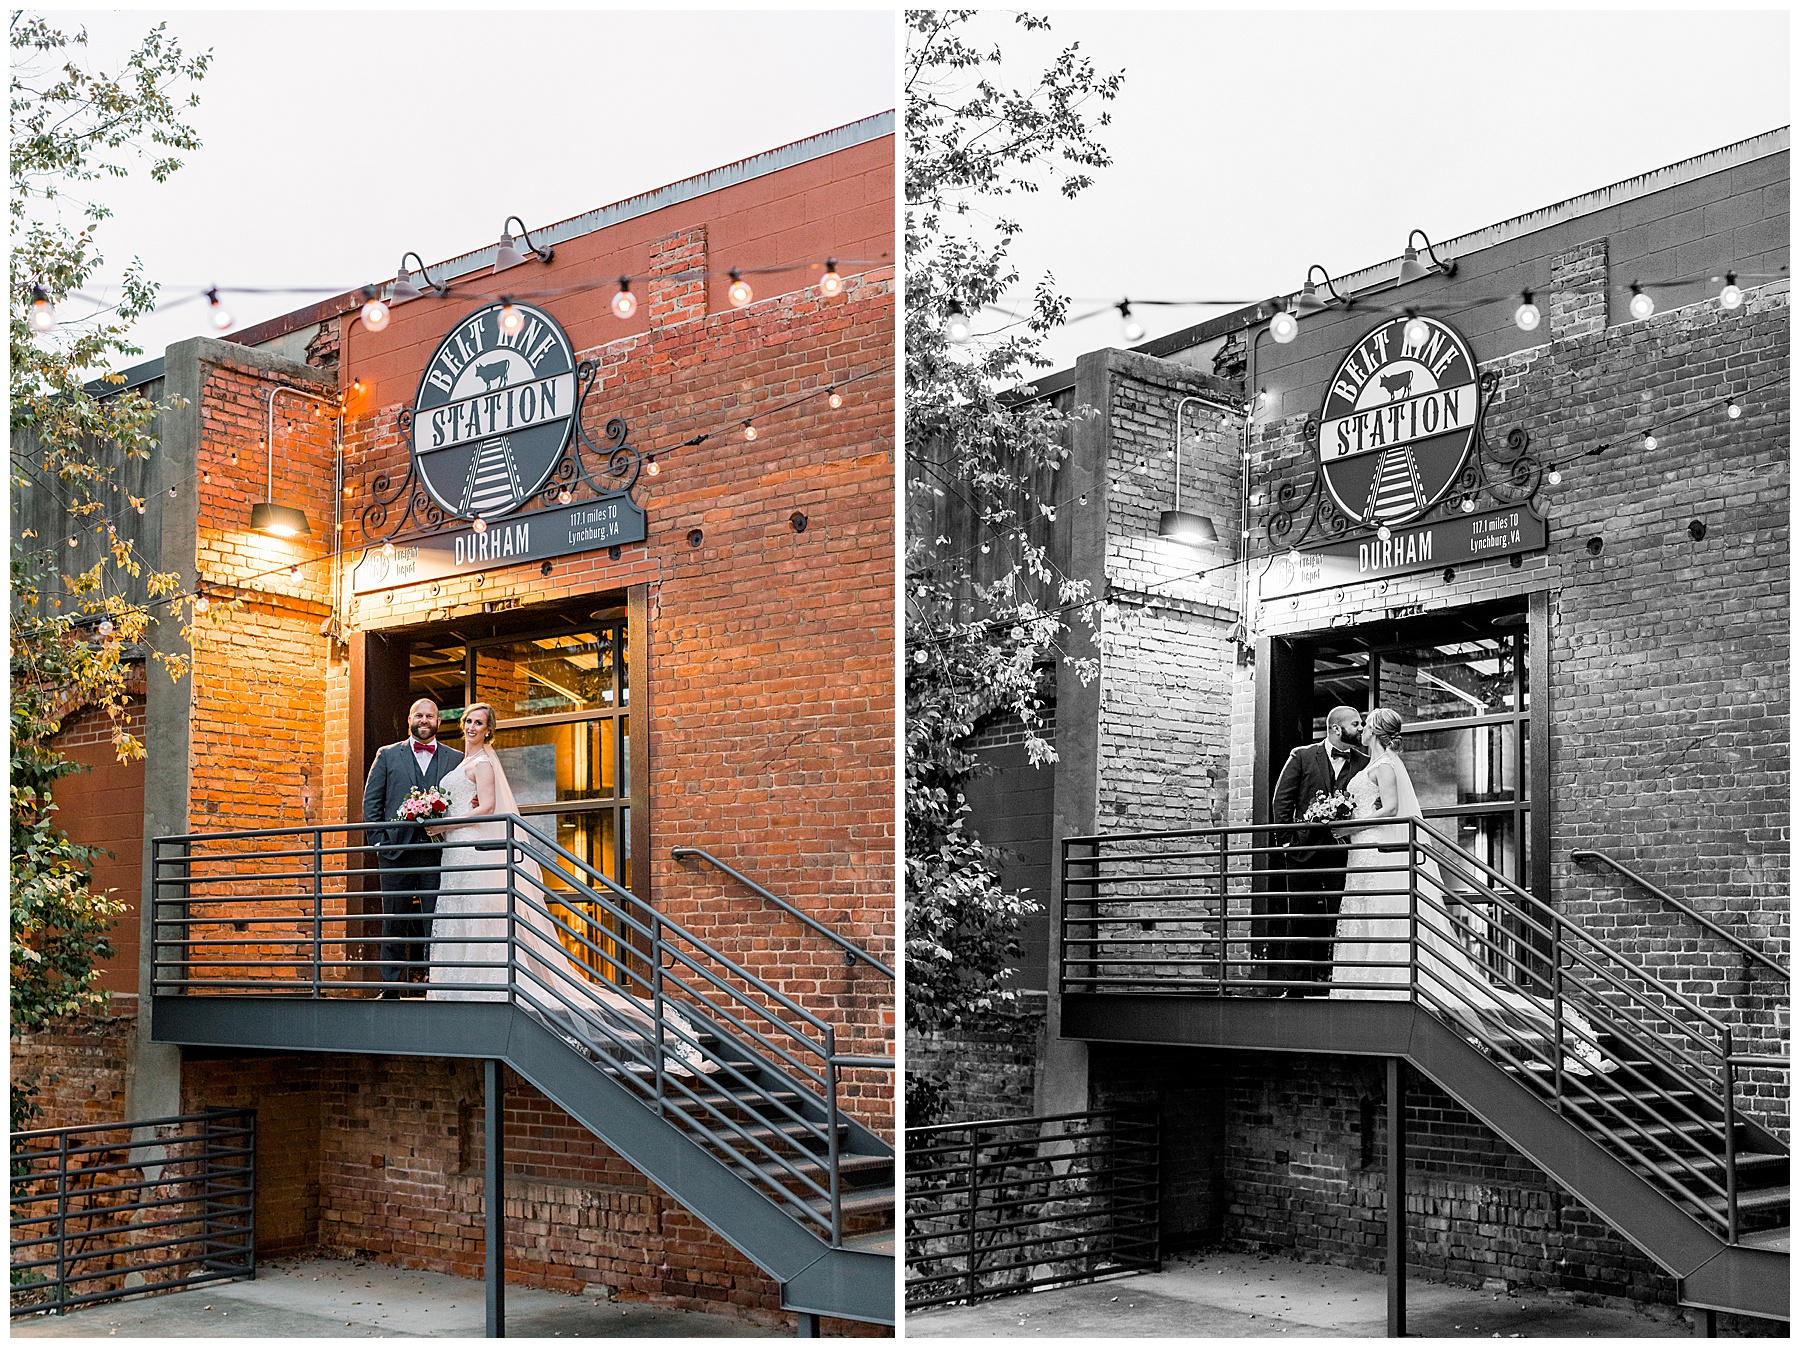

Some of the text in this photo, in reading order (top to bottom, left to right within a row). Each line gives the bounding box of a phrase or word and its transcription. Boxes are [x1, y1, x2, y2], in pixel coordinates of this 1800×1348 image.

[428, 317, 486, 394] BELT
[1333, 329, 1390, 405] BELT
[432, 379, 557, 447] STATION
[1337, 389, 1460, 456] STATION
[570, 504, 617, 527] 117.1 miles TO
[609, 521, 619, 536] VA
[1472, 512, 1519, 535] 117.1 miles TO
[1510, 529, 1521, 544] VA
[454, 522, 530, 567] DURHAM
[1358, 530, 1433, 573] DURHAM
